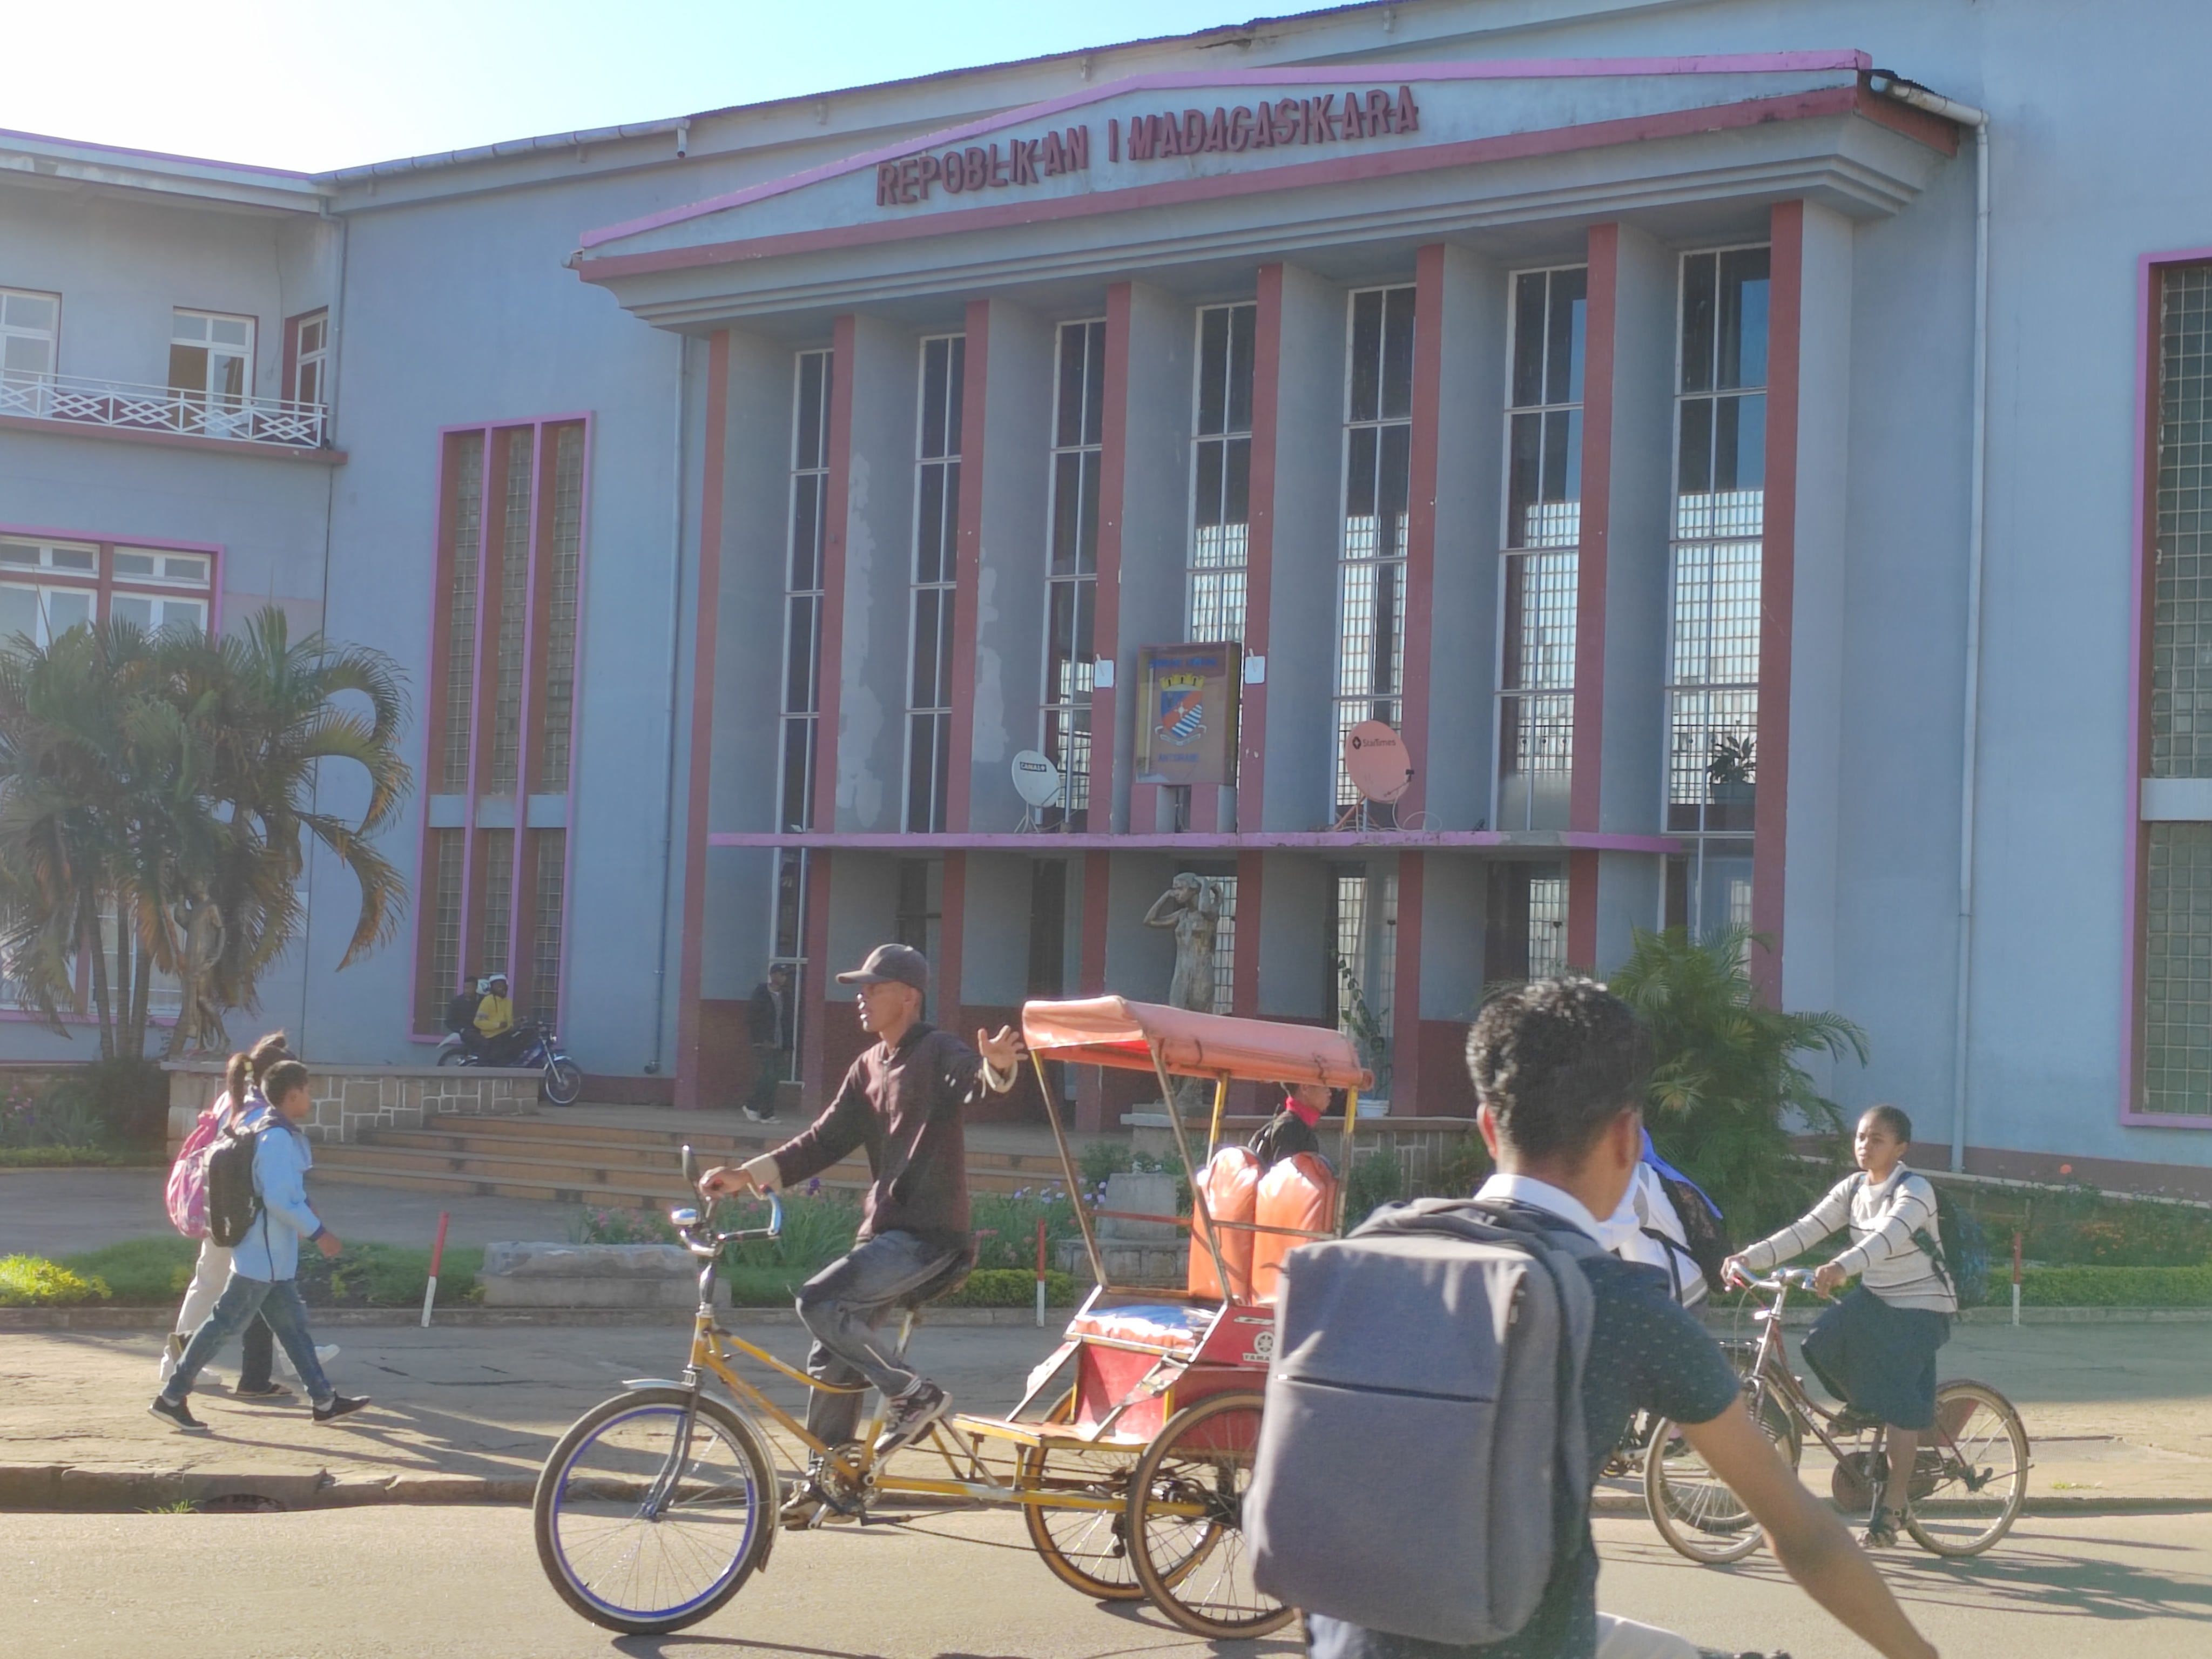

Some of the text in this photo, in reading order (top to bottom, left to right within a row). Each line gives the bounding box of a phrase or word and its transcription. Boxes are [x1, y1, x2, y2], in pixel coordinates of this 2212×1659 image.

[876, 85, 1419, 206] REPOBLIKAN I MADAGASIKARA
[1363, 739, 1396, 747] StarTimes
